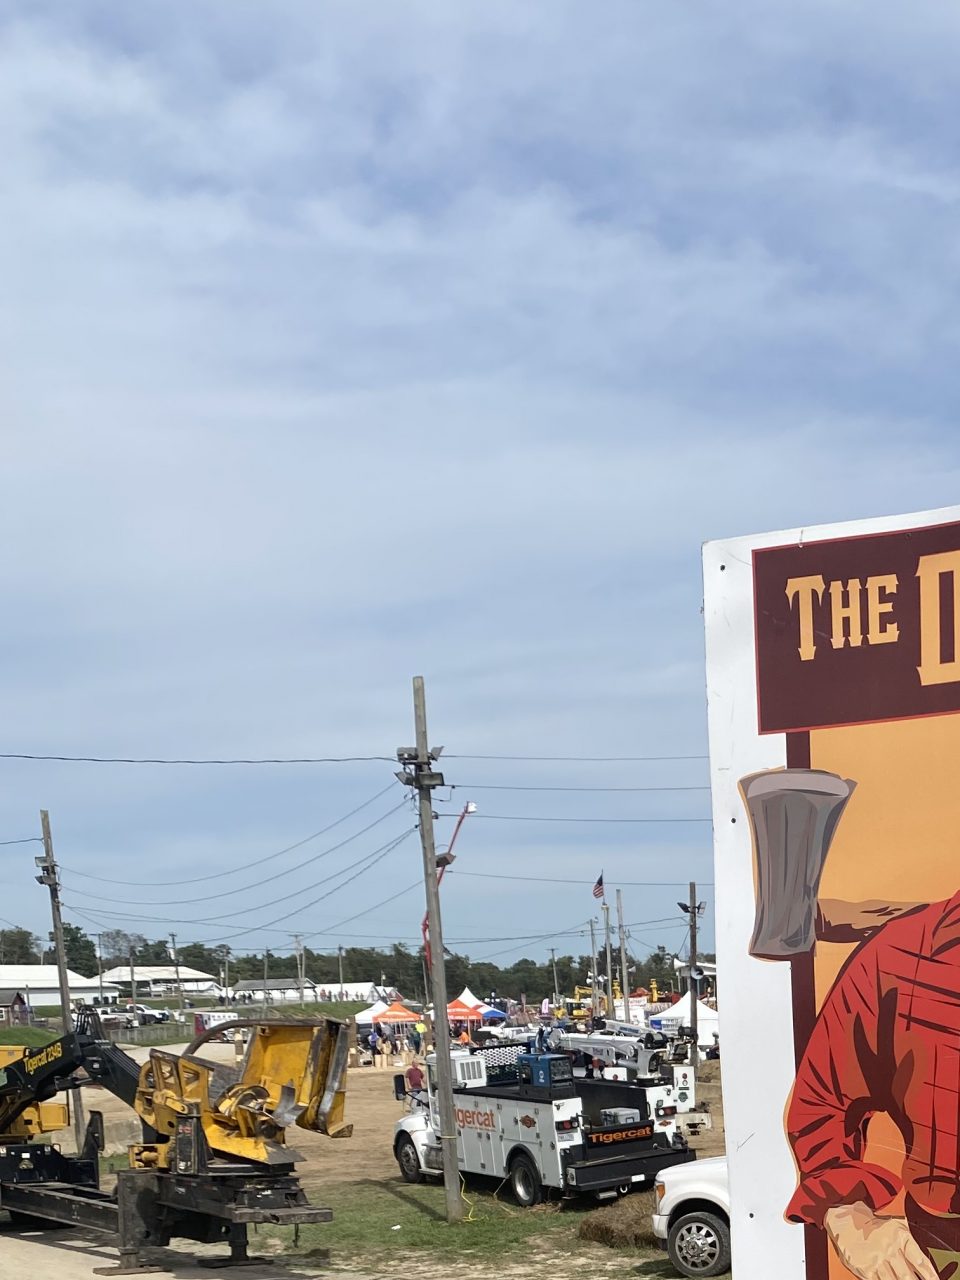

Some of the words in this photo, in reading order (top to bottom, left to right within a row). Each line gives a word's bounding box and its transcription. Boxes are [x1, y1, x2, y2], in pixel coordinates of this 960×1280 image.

[784, 575, 901, 661] THE
[23, 1048, 47, 1075] Tigercat
[454, 1107, 496, 1129] igercat
[588, 1125, 652, 1144] Tigercat
